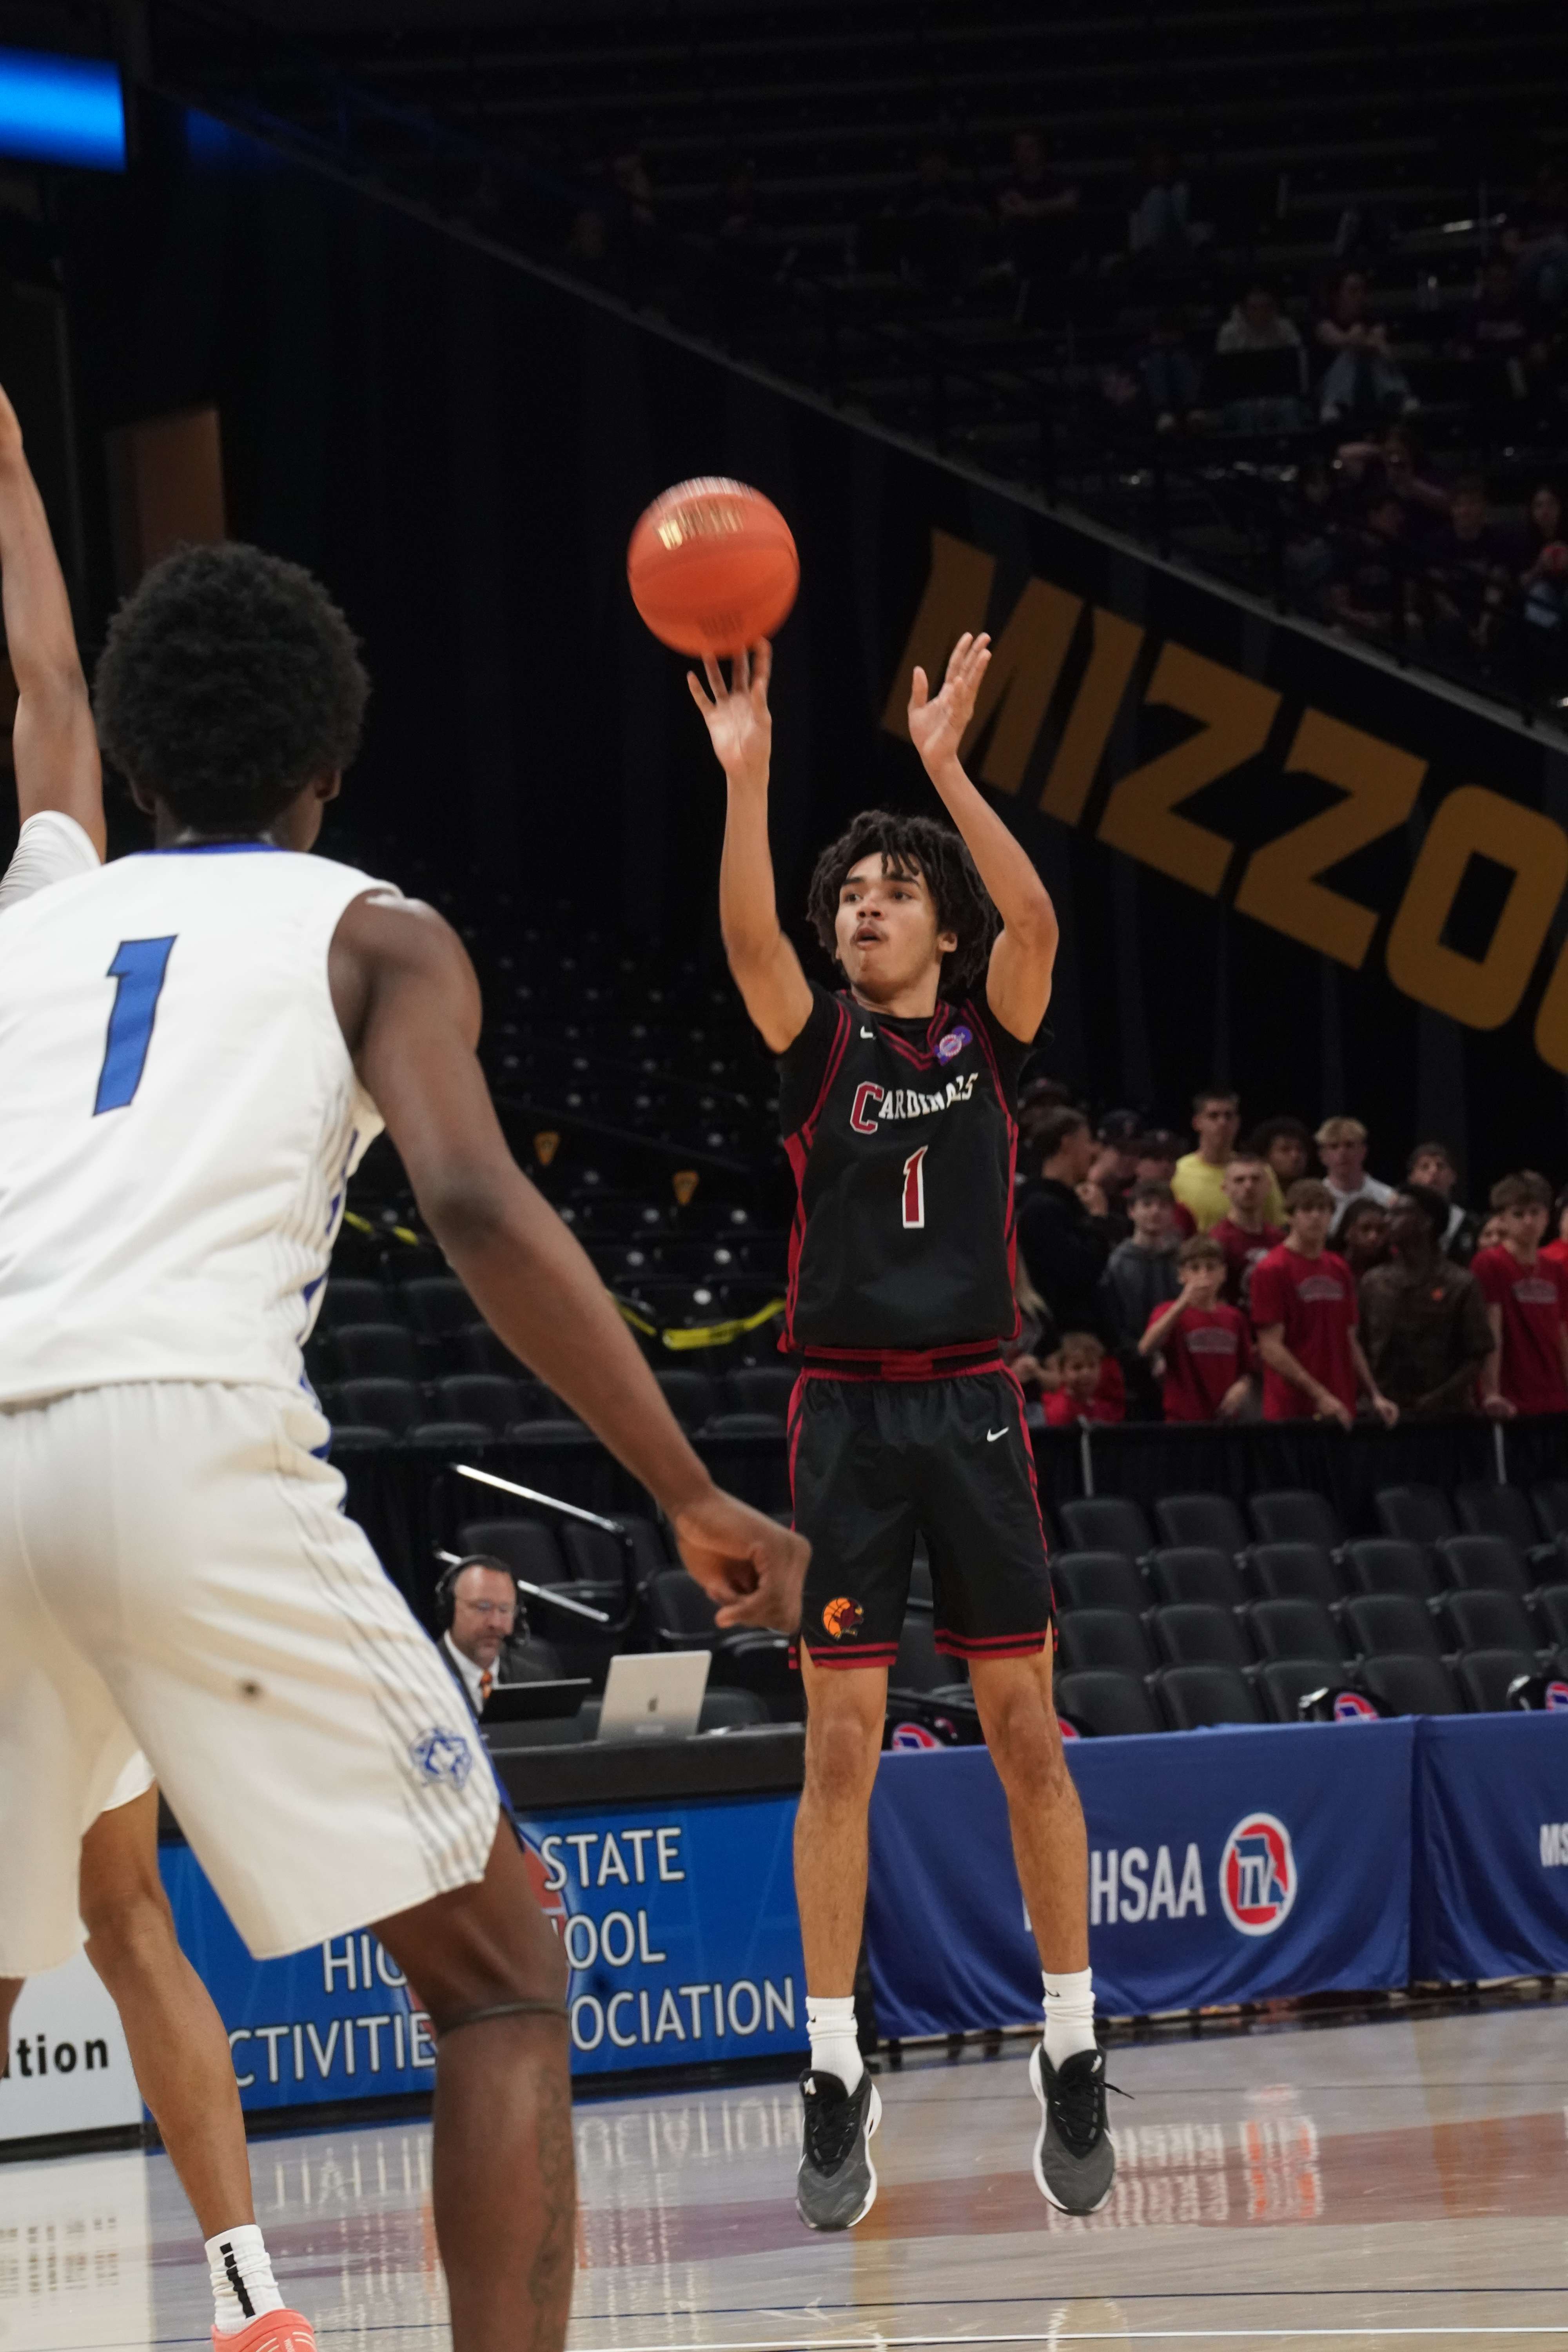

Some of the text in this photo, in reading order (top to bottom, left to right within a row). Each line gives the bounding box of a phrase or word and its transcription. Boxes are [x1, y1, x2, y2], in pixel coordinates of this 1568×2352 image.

[881, 528, 1568, 1076] MIZZO
[92, 933, 178, 1116] 1
[902, 1145, 928, 1229] 1
[541, 1827, 685, 1891] STATE
[1022, 1842, 1207, 1932] HSAA
[3, 2033, 108, 2078] tion
[229, 1977, 796, 2087] CTIVITIE OCIATION
